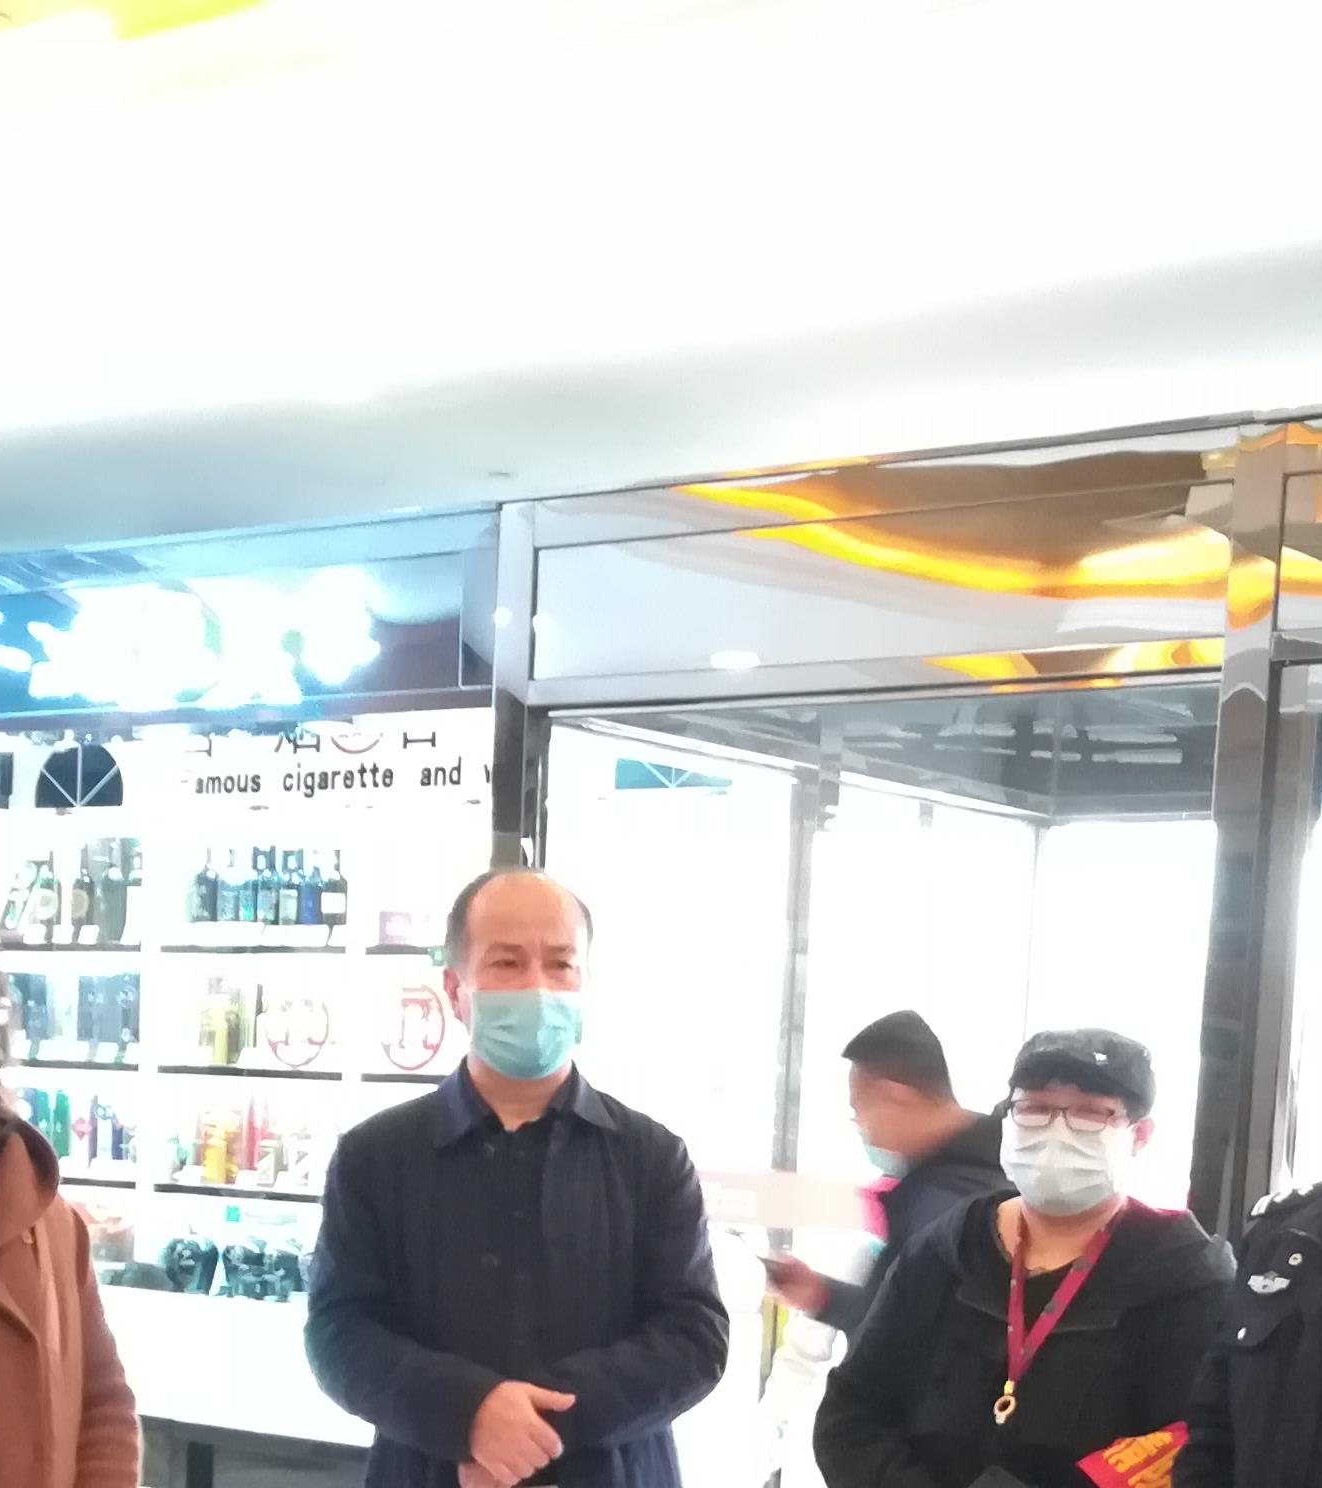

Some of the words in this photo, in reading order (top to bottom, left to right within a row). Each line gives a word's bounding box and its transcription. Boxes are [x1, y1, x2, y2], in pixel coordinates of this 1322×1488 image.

[180, 773, 262, 795] amous
[282, 762, 394, 799] cigarette
[419, 756, 462, 787] and
